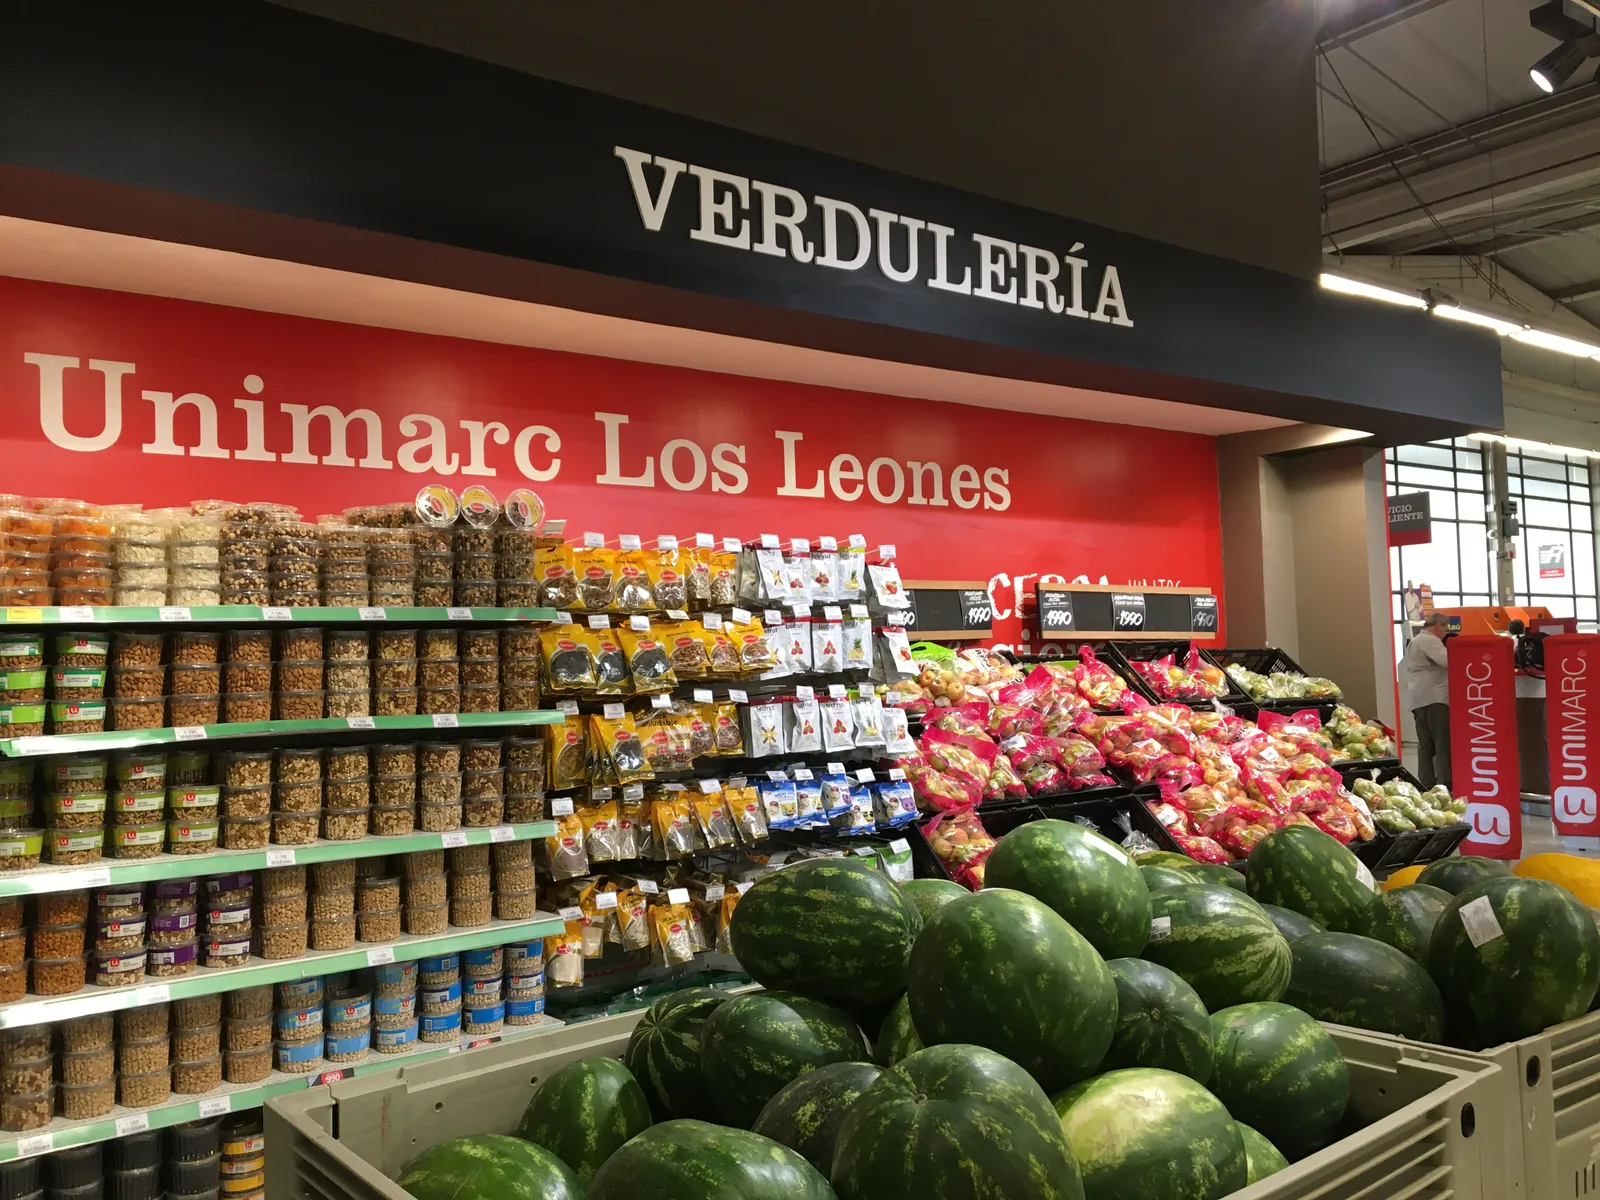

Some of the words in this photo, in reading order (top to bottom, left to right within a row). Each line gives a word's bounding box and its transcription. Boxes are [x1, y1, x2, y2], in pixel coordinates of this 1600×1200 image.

[614, 145, 1134, 328] VERDULERÍA
[23, 351, 562, 482] Unimarc
[594, 411, 749, 495] Los
[774, 430, 1012, 512] Leones
